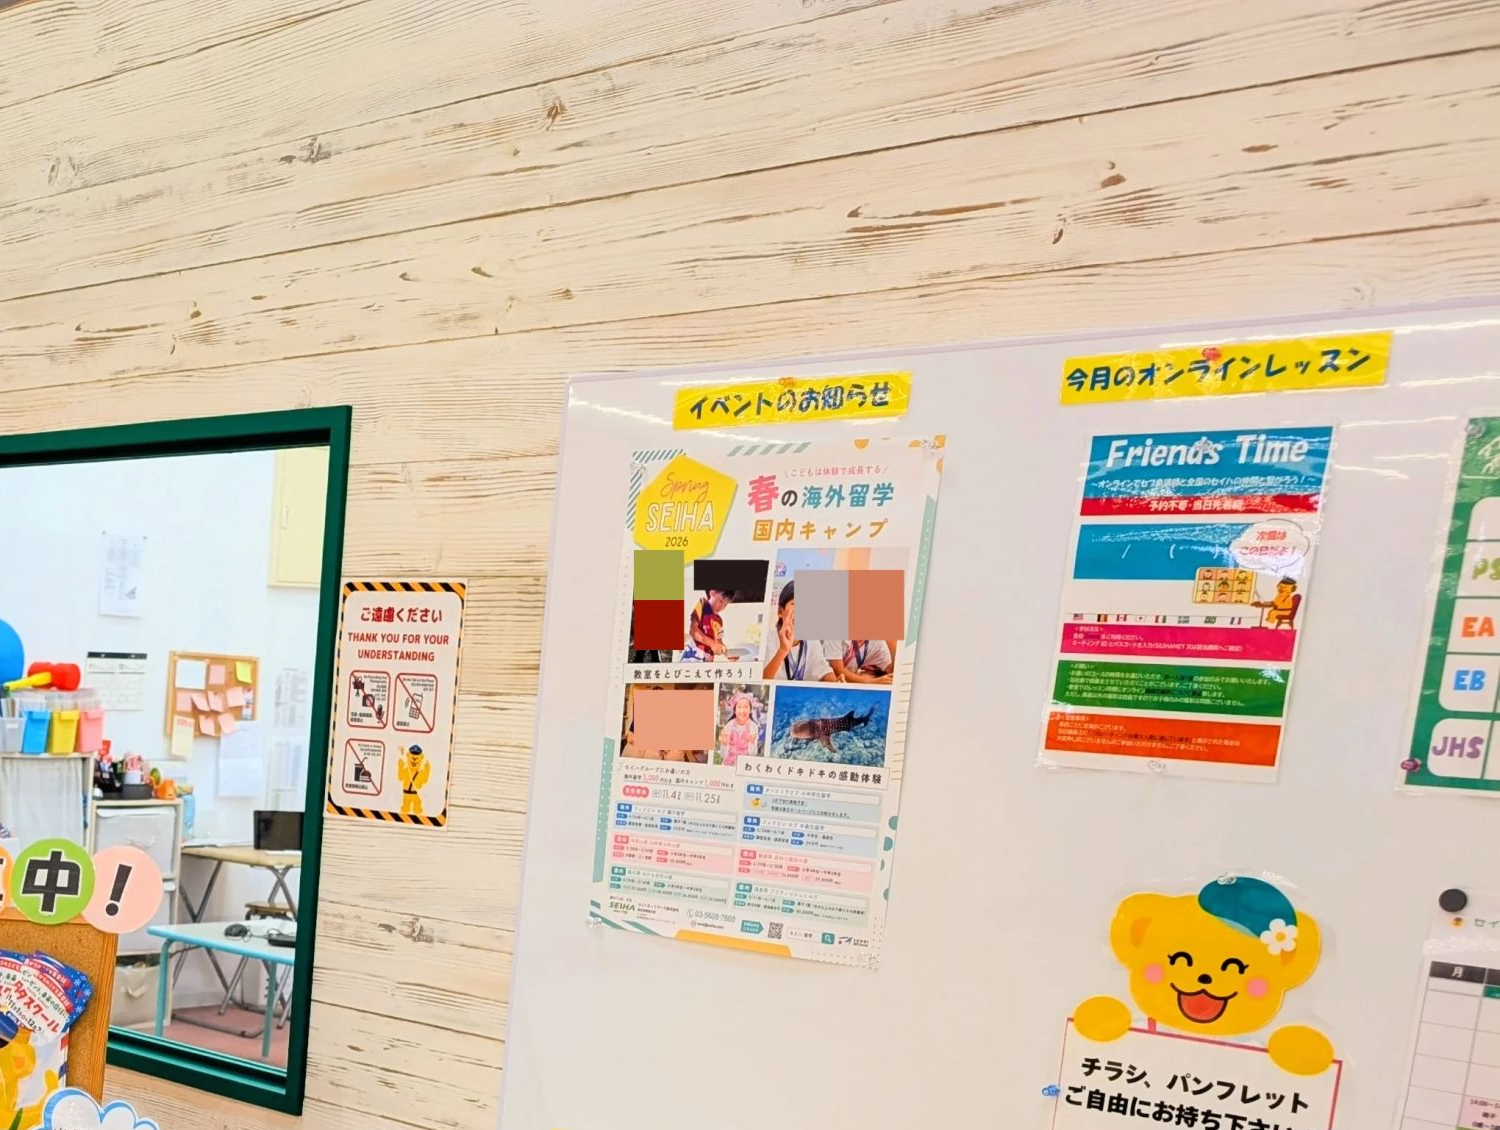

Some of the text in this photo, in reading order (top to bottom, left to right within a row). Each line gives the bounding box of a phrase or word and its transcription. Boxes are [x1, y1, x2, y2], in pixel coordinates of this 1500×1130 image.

[1066, 349, 1371, 391] 今月のオンラインレッスン
[690, 382, 891, 420] イベントのお知らせ
[1107, 433, 1308, 467] Friends Time
[790, 465, 881, 478] こどもは体験で成長する
[660, 472, 709, 504] Spring
[748, 474, 894, 514] 春の海外留学
[645, 500, 714, 533] SEIHA
[753, 519, 888, 542] 国内キャンプ
[665, 536, 689, 548] 2026
[361, 607, 442, 623] ご遠慮ください
[1461, 616, 1496, 638] EA
[348, 632, 449, 646] THANK YOU FOR YOUR
[357, 649, 435, 662] UNDERSTANDING
[1453, 670, 1486, 691] EB
[1432, 736, 1485, 759] JHS
[744, 761, 882, 785] わくわくドキドキの感動体験
[609, 902, 635, 911] SEIHA
[1452, 967, 1463, 977] 月
